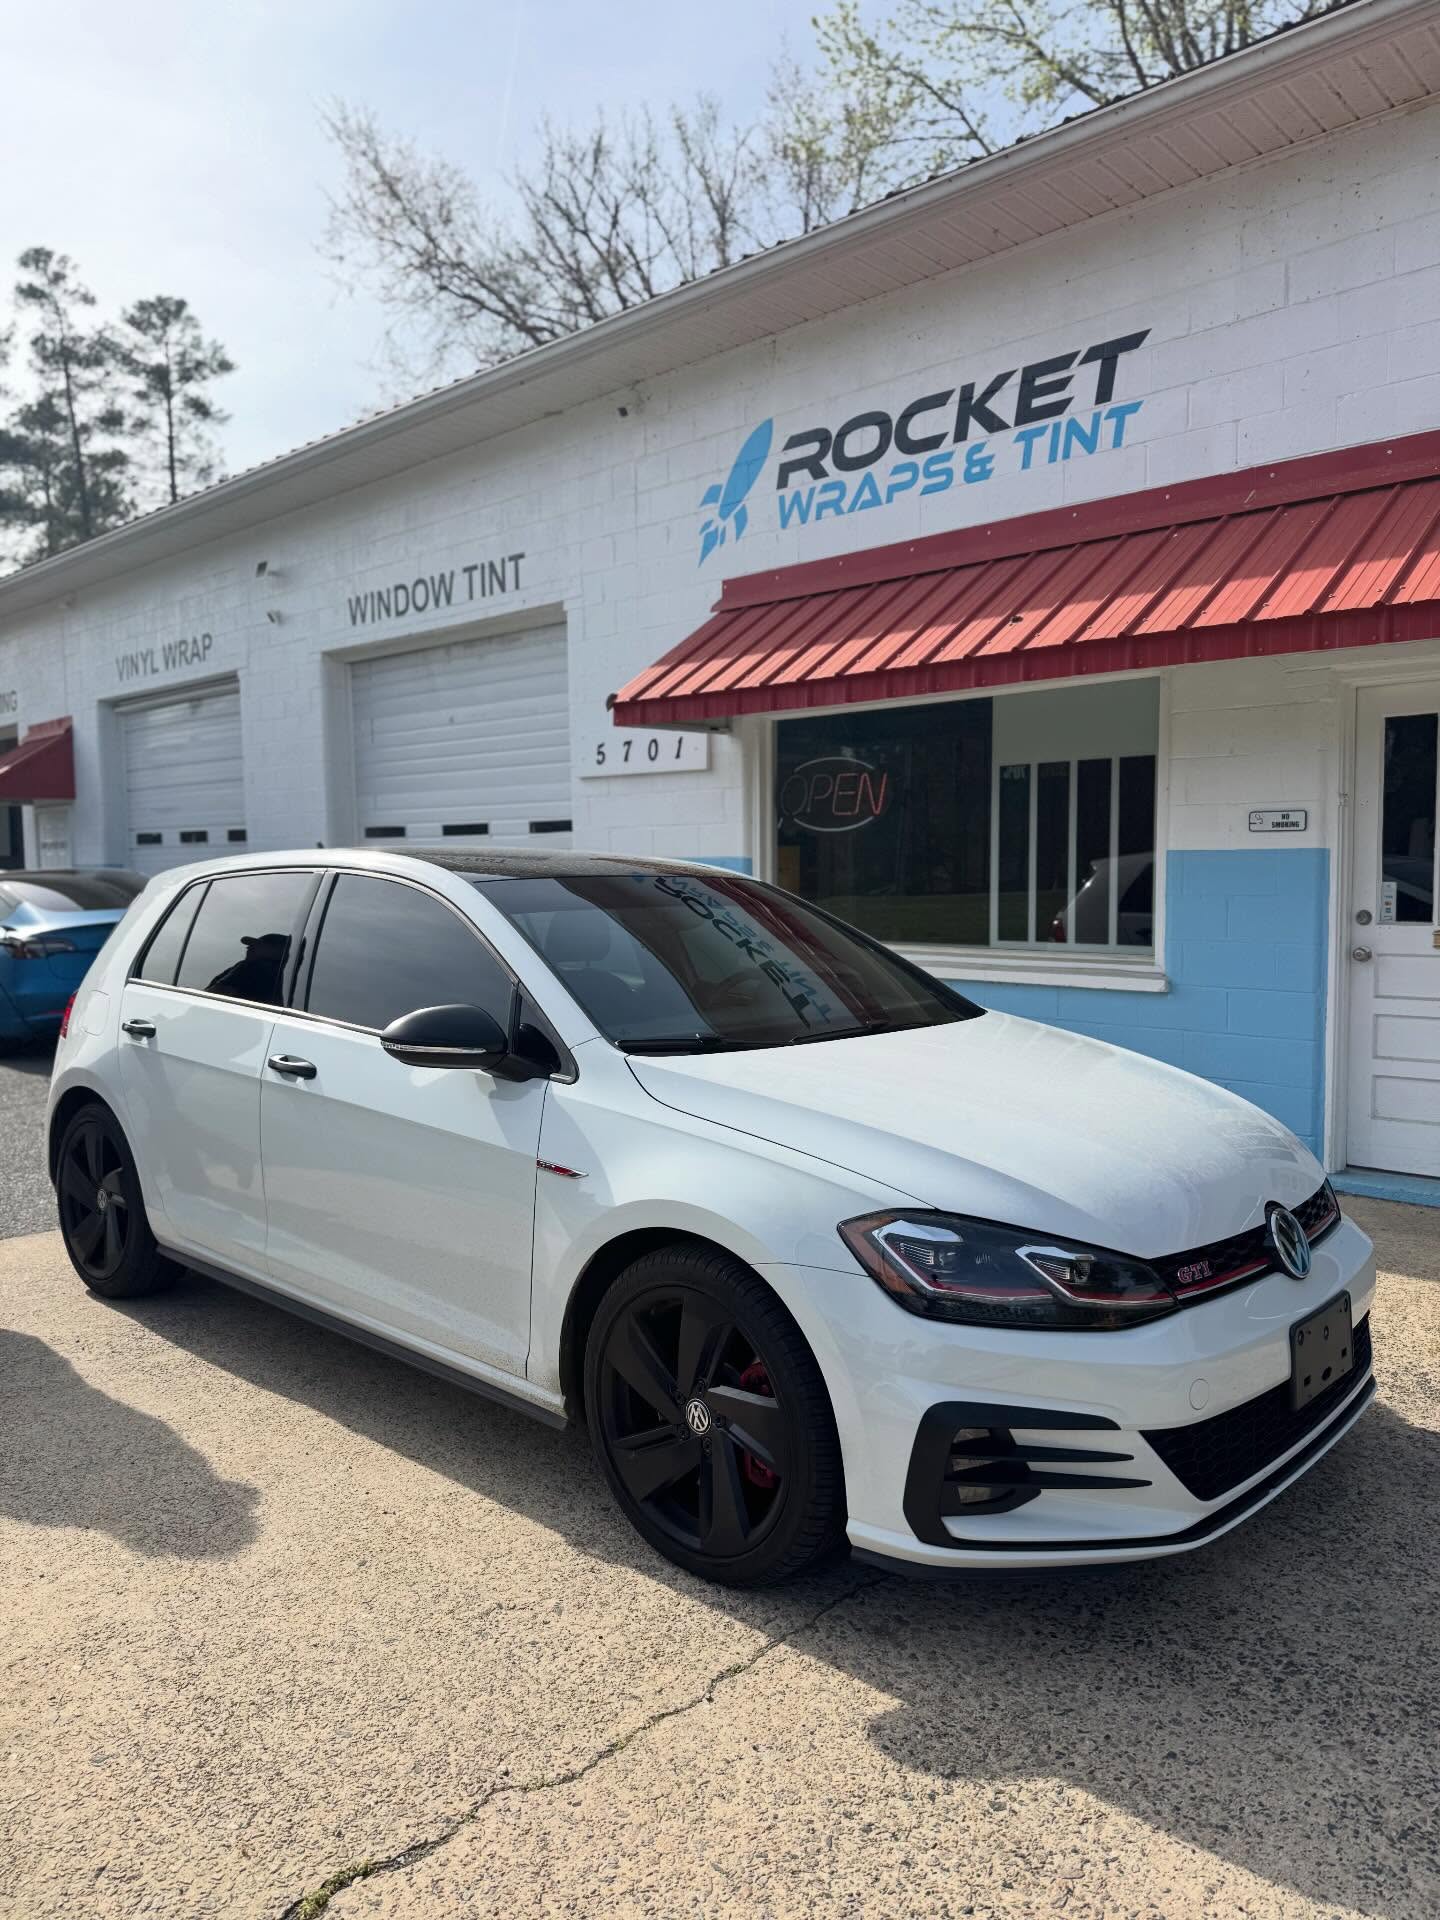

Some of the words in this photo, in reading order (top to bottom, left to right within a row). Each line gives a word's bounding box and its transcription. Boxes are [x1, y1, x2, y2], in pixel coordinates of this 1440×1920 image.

[776, 328, 1152, 489] ROCKET
[778, 450, 956, 529] WRAPS
[963, 440, 996, 485] &
[1013, 399, 1145, 471] TINT
[348, 569, 455, 626] WINDOW
[462, 552, 526, 601] TINT
[115, 648, 160, 682] VINYL
[162, 632, 213, 671] WRAP
[781, 772, 888, 816] OPEN
[1177, 1259, 1212, 1284] GTI
